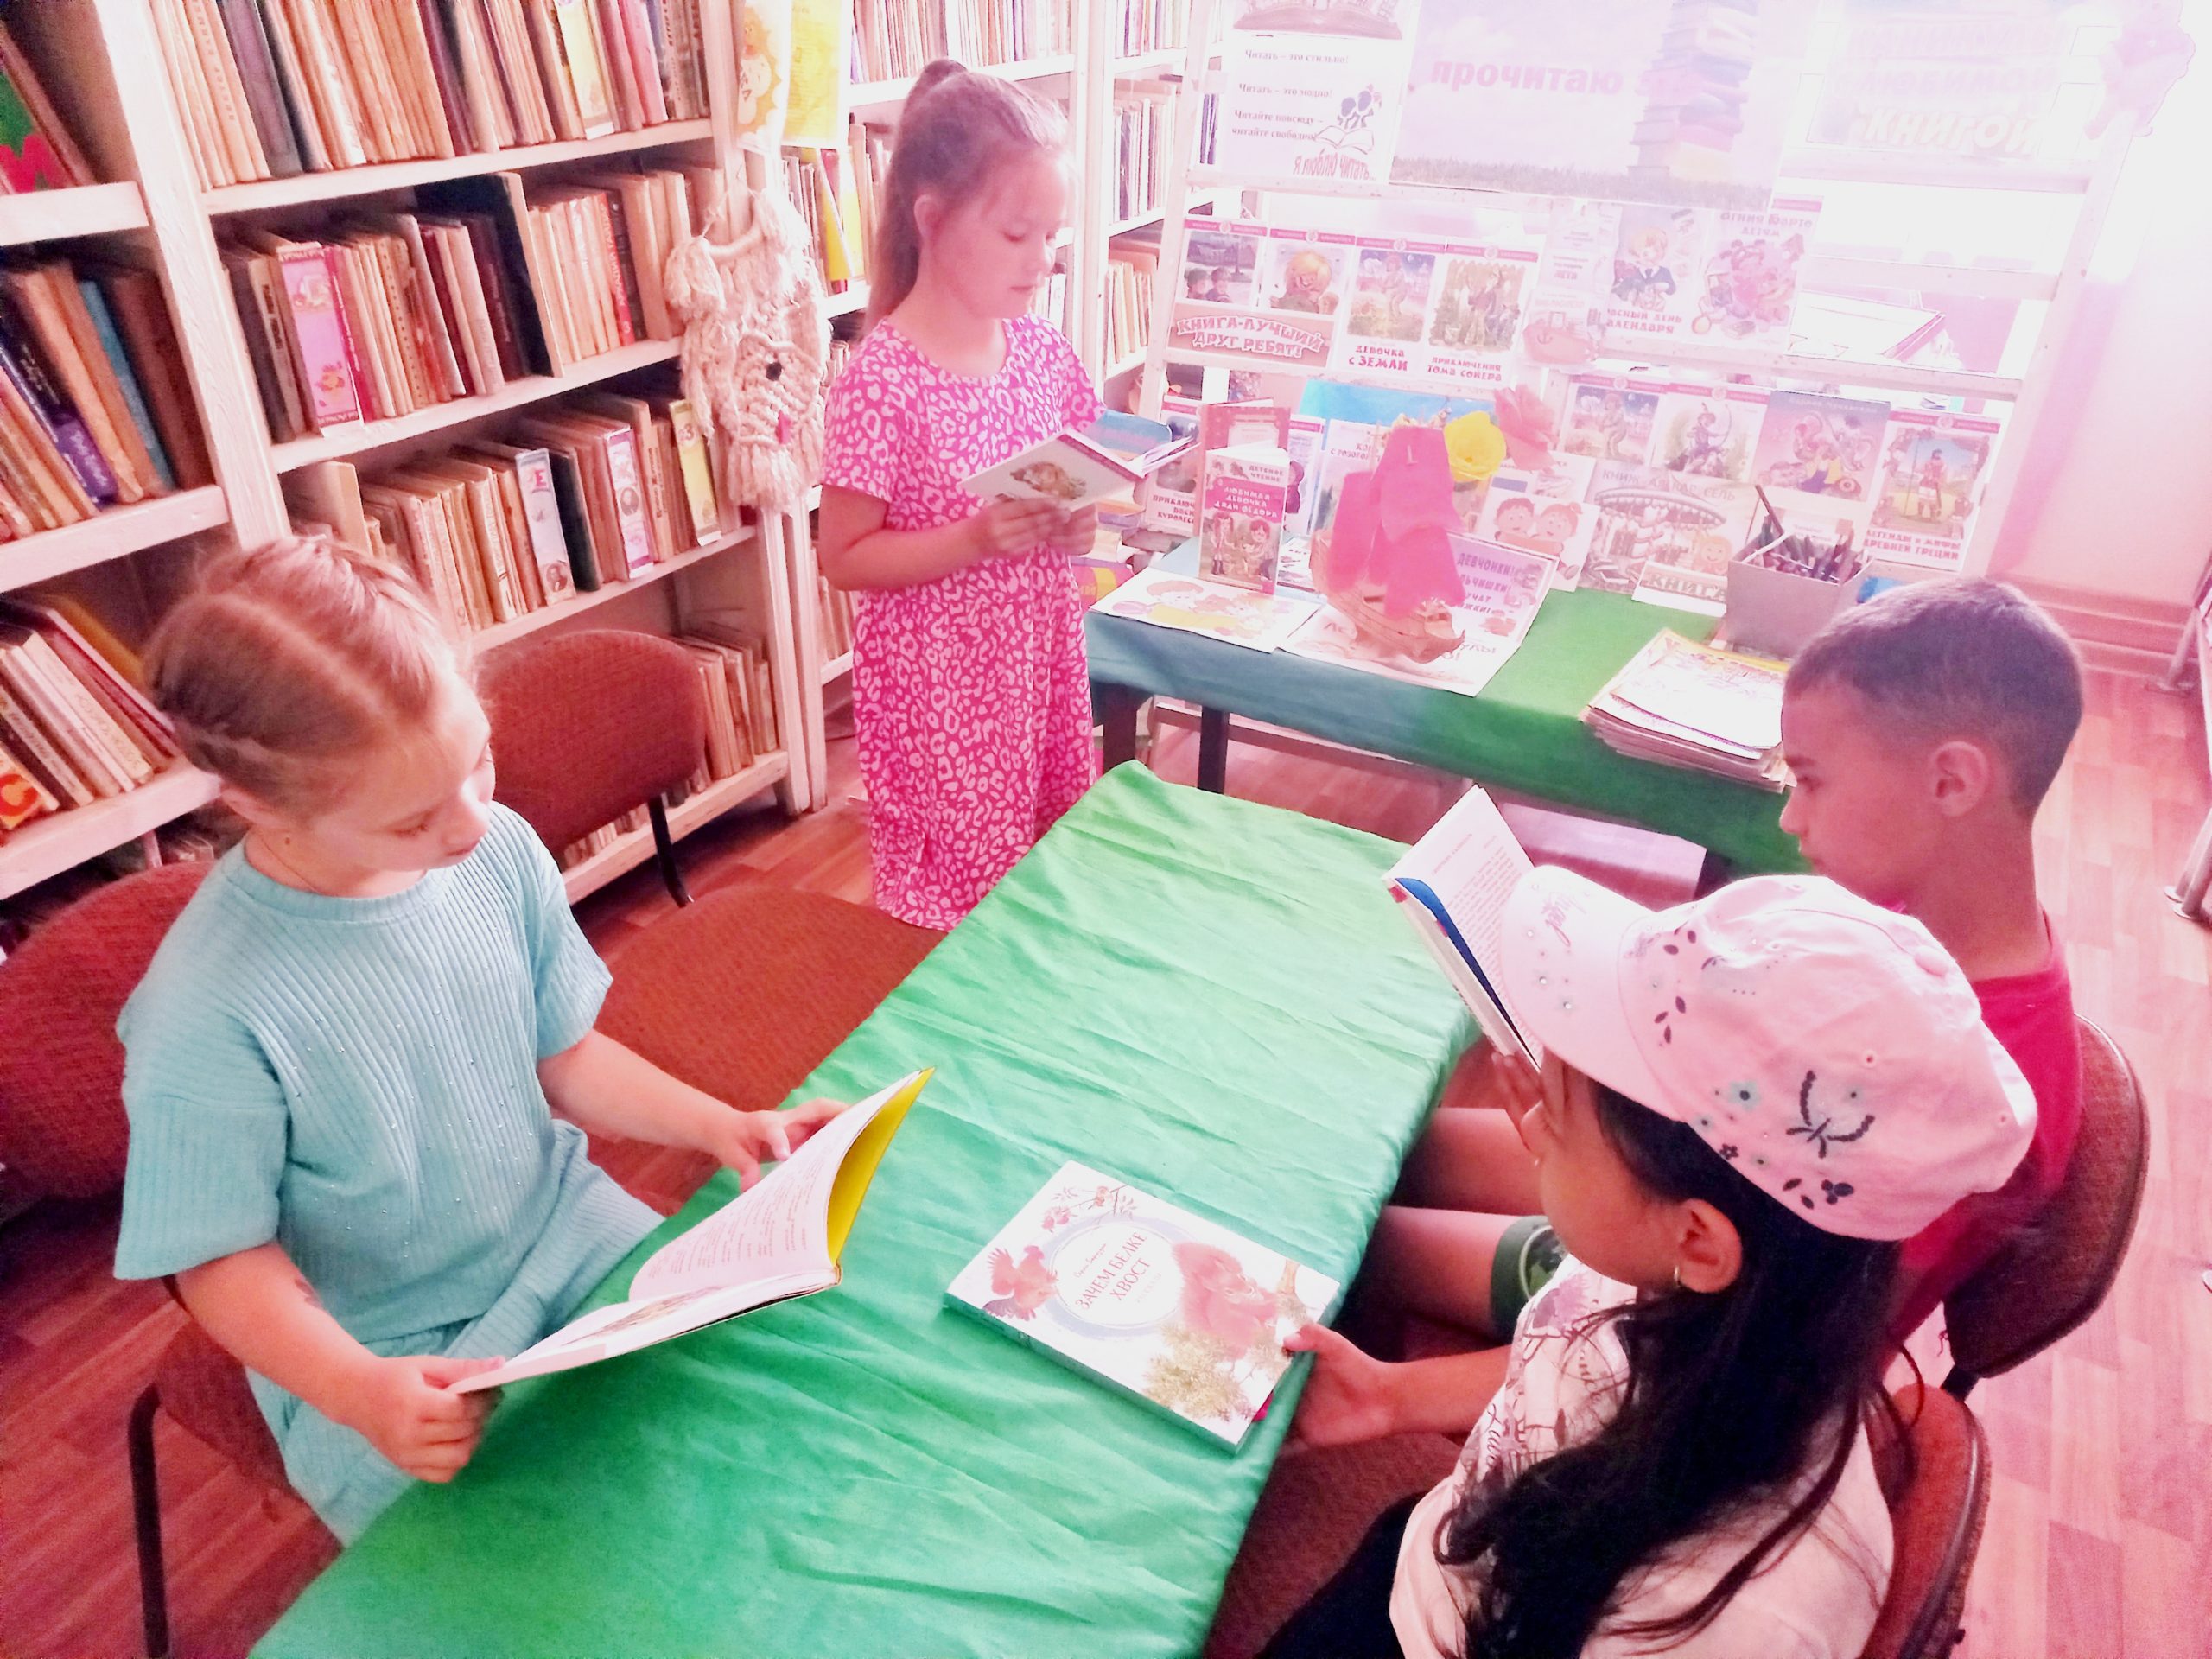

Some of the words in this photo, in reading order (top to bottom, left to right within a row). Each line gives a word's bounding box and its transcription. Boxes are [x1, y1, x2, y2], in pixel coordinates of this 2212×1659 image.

[1244, 48, 1279, 61] Читать
[1288, 54, 1304, 62] это
[1306, 54, 1349, 64] стильно!
[1429, 59, 1624, 96] прочитаю
[1238, 82, 1273, 95] Читать
[1299, 88, 1334, 99] модно!
[1234, 109, 1275, 123] Читайте
[1276, 111, 1314, 126] повсюду
[1231, 127, 1270, 139] читайте
[1293, 155, 1302, 175] Я
[1192, 330, 1237, 349] ДРУГ
[1242, 334, 1303, 359] РЕБЯТ!
[1357, 353, 1409, 372] ЗЕМЛИ
[1457, 552, 1516, 577] ДЕВЧОНКИ!
[1074, 1268, 1116, 1310] ЗАЧЕМ
[1108, 1231, 1147, 1271] БЕЛКЕ
[1109, 1258, 1150, 1301] ХВОСТ
